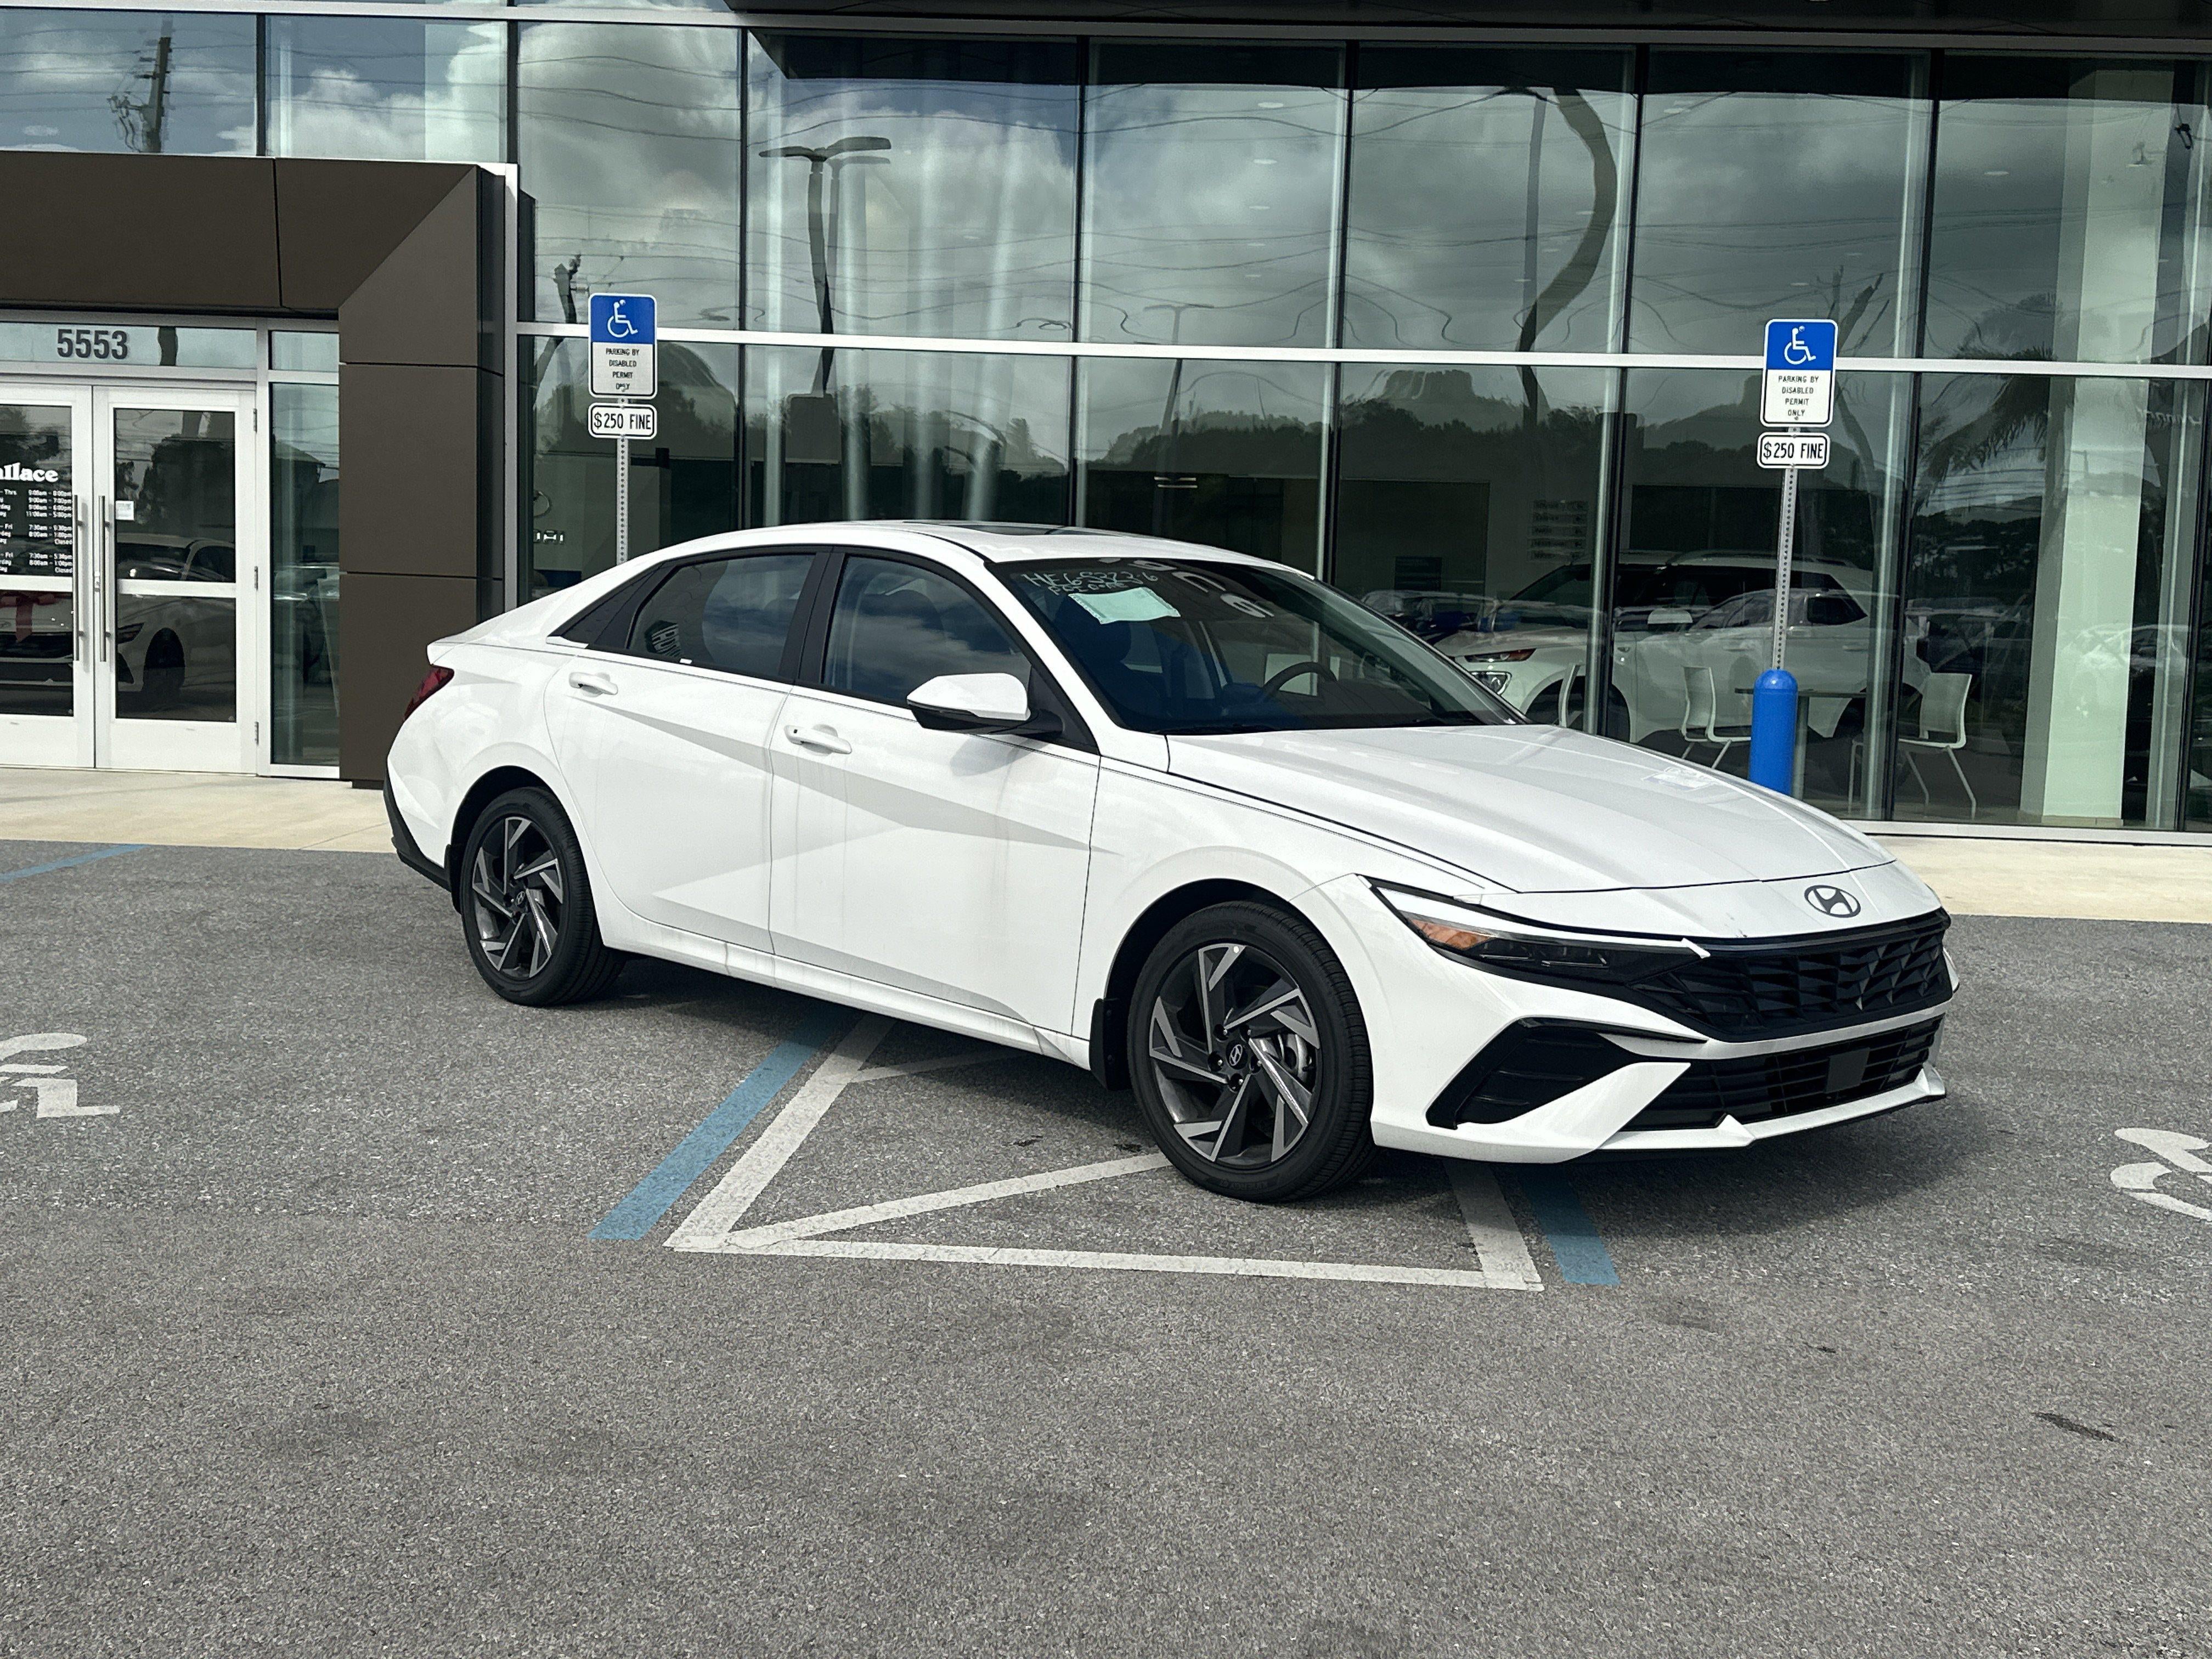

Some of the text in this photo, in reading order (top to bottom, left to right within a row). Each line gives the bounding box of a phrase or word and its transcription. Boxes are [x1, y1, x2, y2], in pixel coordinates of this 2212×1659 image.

[57, 328, 128, 360] 5553
[605, 347, 630, 356] PARKING
[1778, 375, 1807, 383] PARKING
[1781, 386, 1814, 394] DISABLED
[594, 411, 652, 430] $250 FINE
[1763, 441, 1824, 460] $250 FINE
